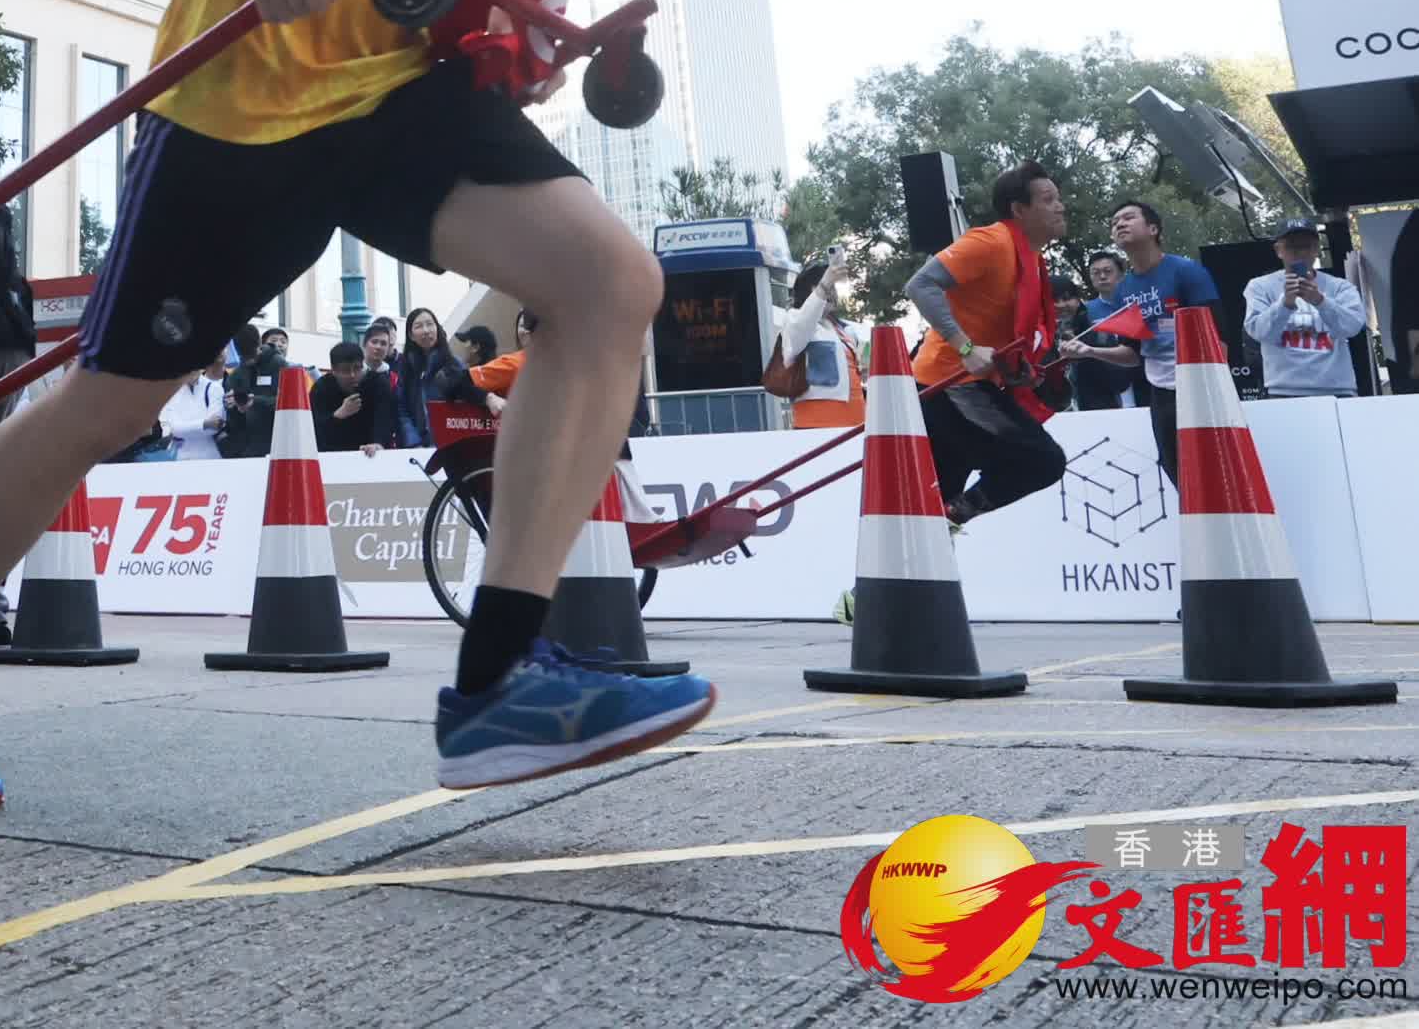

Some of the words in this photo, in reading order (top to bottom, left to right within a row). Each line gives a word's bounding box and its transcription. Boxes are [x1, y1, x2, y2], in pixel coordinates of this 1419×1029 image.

[1335, 27, 1419, 59] COC
[679, 233, 710, 242] PCCW
[41, 299, 64, 312] HGC
[1123, 285, 1159, 307] Think
[674, 298, 735, 322] Wi-Fi
[446, 418, 469, 429] ROUND
[131, 493, 211, 555] 75
[204, 493, 229, 554] YEARS
[326, 498, 459, 528] Chartwll
[355, 528, 457, 571] Capial
[118, 561, 164, 576] HONG
[168, 560, 214, 576] KONG
[1062, 563, 1176, 591] HKANST
